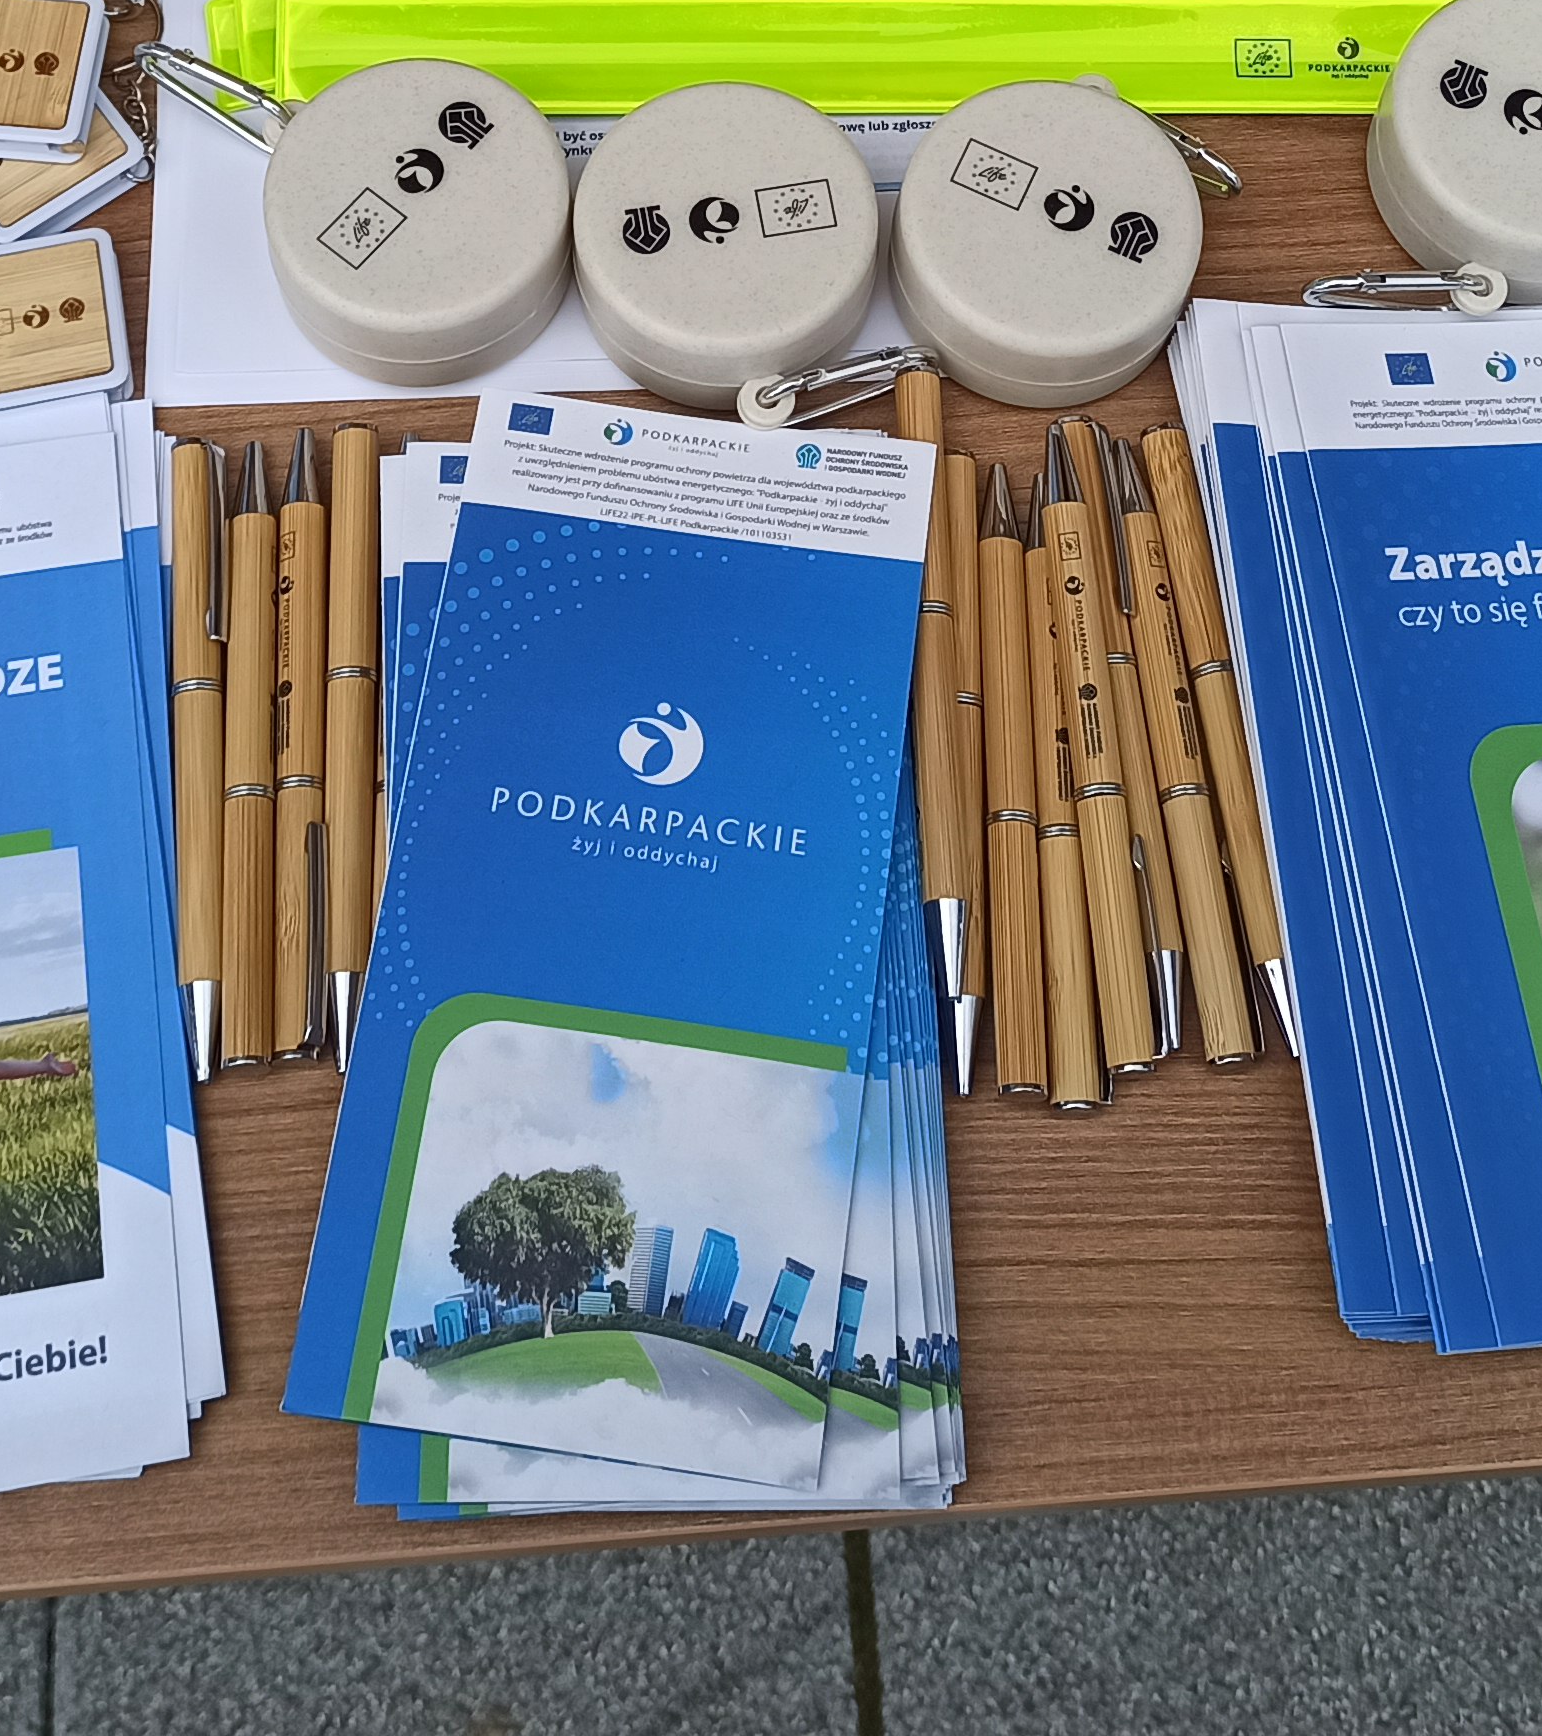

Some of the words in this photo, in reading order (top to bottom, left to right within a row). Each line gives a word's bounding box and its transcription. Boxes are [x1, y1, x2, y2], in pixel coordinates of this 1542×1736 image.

[641, 428, 749, 452] PODKARPACKIE
[1398, 605, 1442, 632] czy
[1449, 600, 1481, 623] to
[1488, 595, 1527, 627] się
[491, 786, 806, 855] PODKARPACKIE
[571, 835, 600, 856] żyj
[609, 840, 615, 854] i
[623, 844, 717, 872] oddychaj
